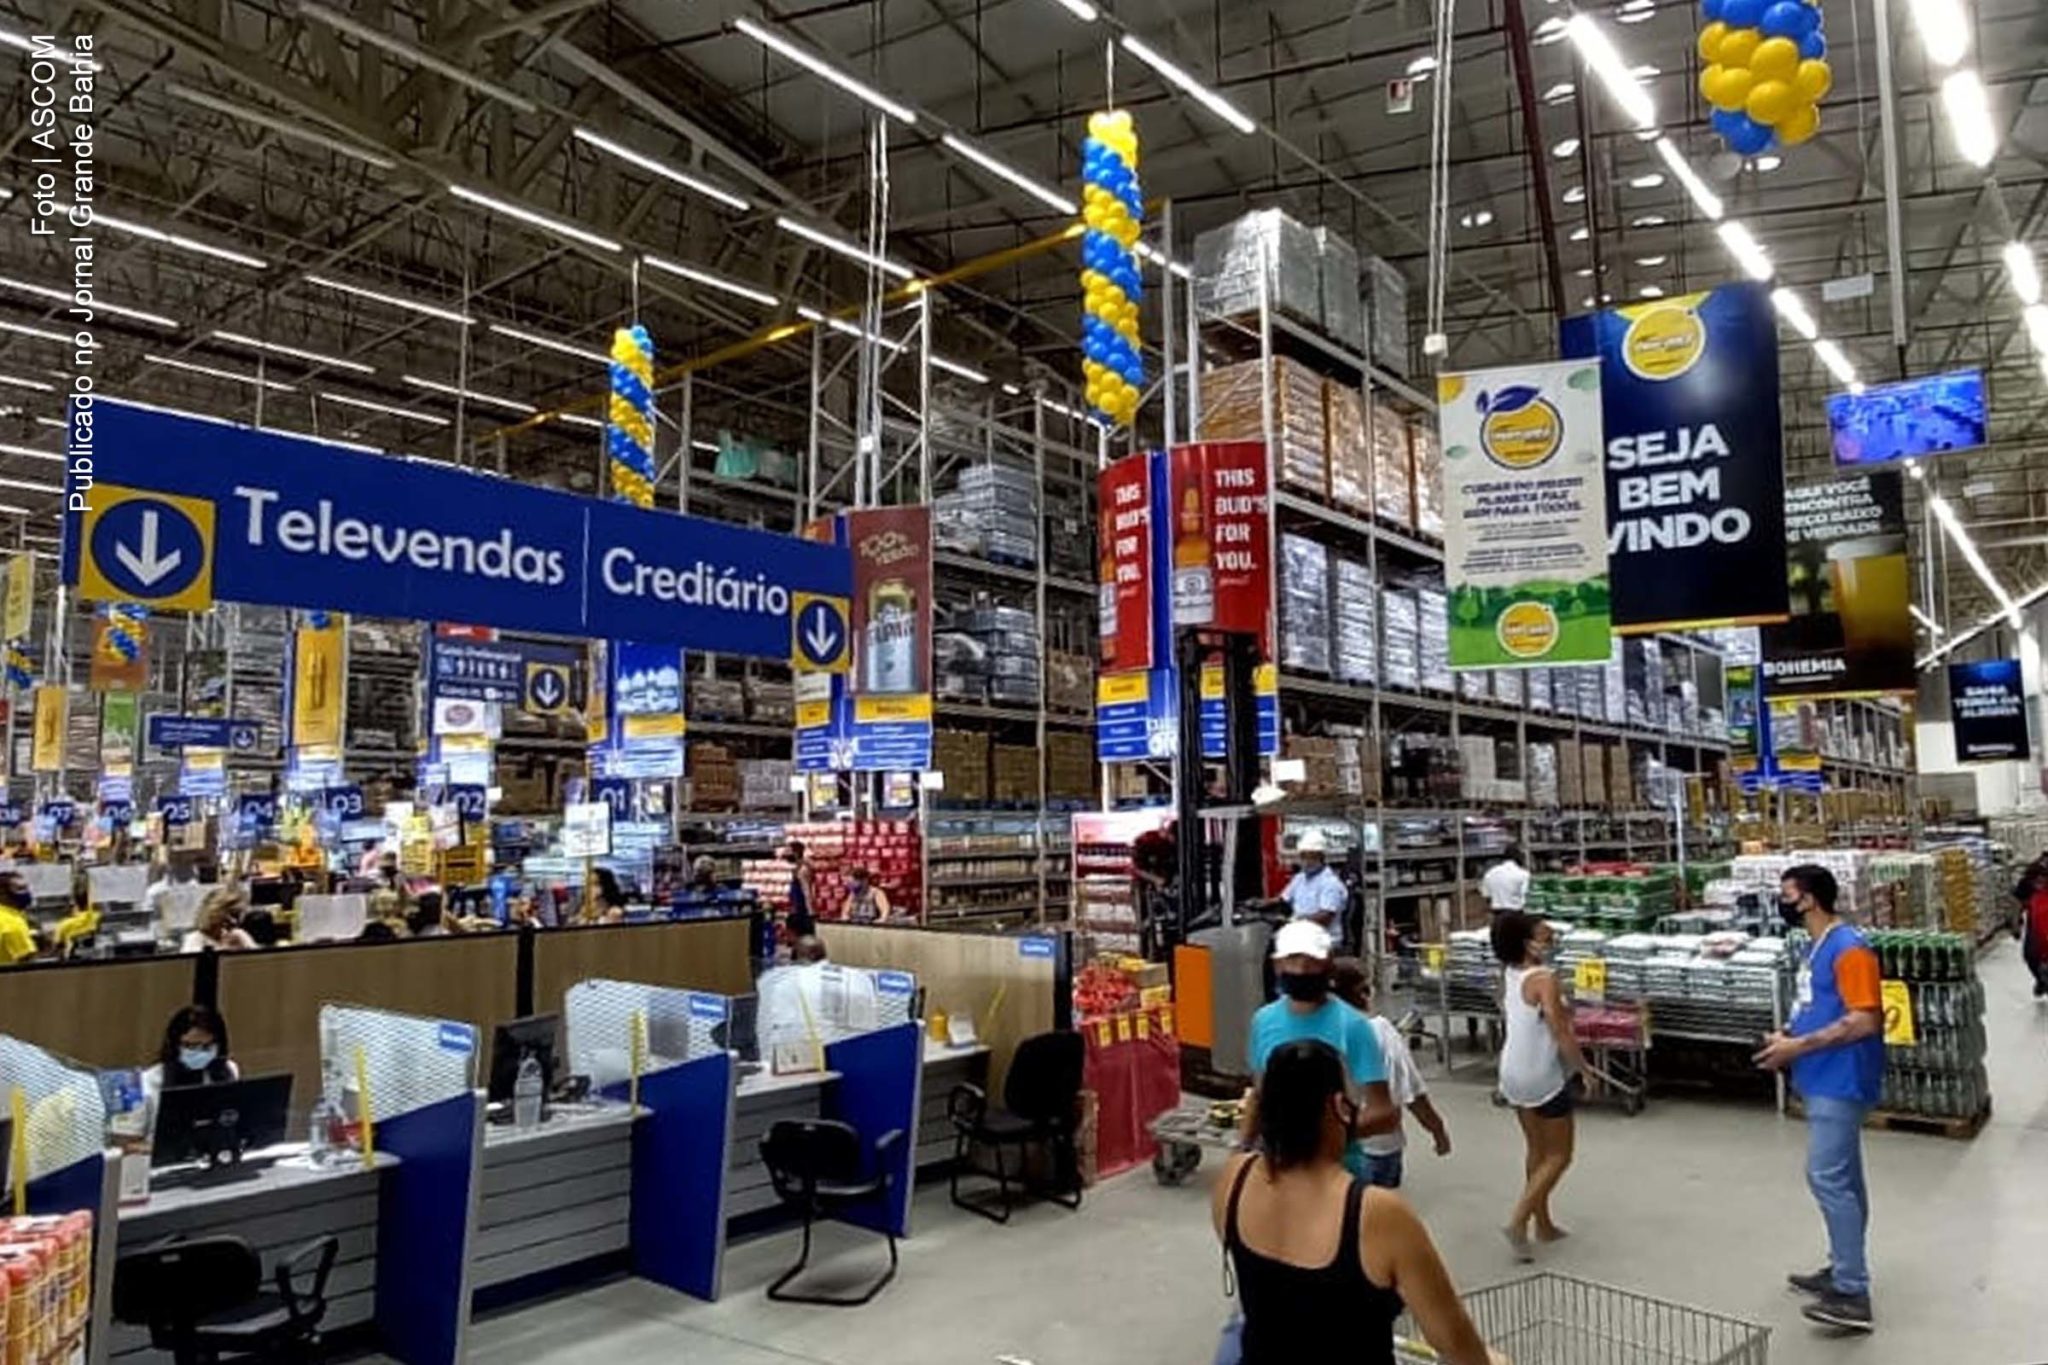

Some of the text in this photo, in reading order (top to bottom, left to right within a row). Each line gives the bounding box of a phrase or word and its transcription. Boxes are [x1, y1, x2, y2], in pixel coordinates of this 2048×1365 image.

[1607, 423, 1730, 470] SEJA
[1214, 467, 1255, 488] THIS
[1618, 466, 1721, 511] BEM
[1215, 494, 1269, 516] BUD'S
[234, 485, 565, 586] Televendas
[1215, 522, 1251, 544] FOR
[1214, 550, 1258, 571] YOU.
[602, 547, 789, 616] Crediário
[1763, 658, 1846, 677] BOHEMIA
[332, 793, 363, 815] 03
